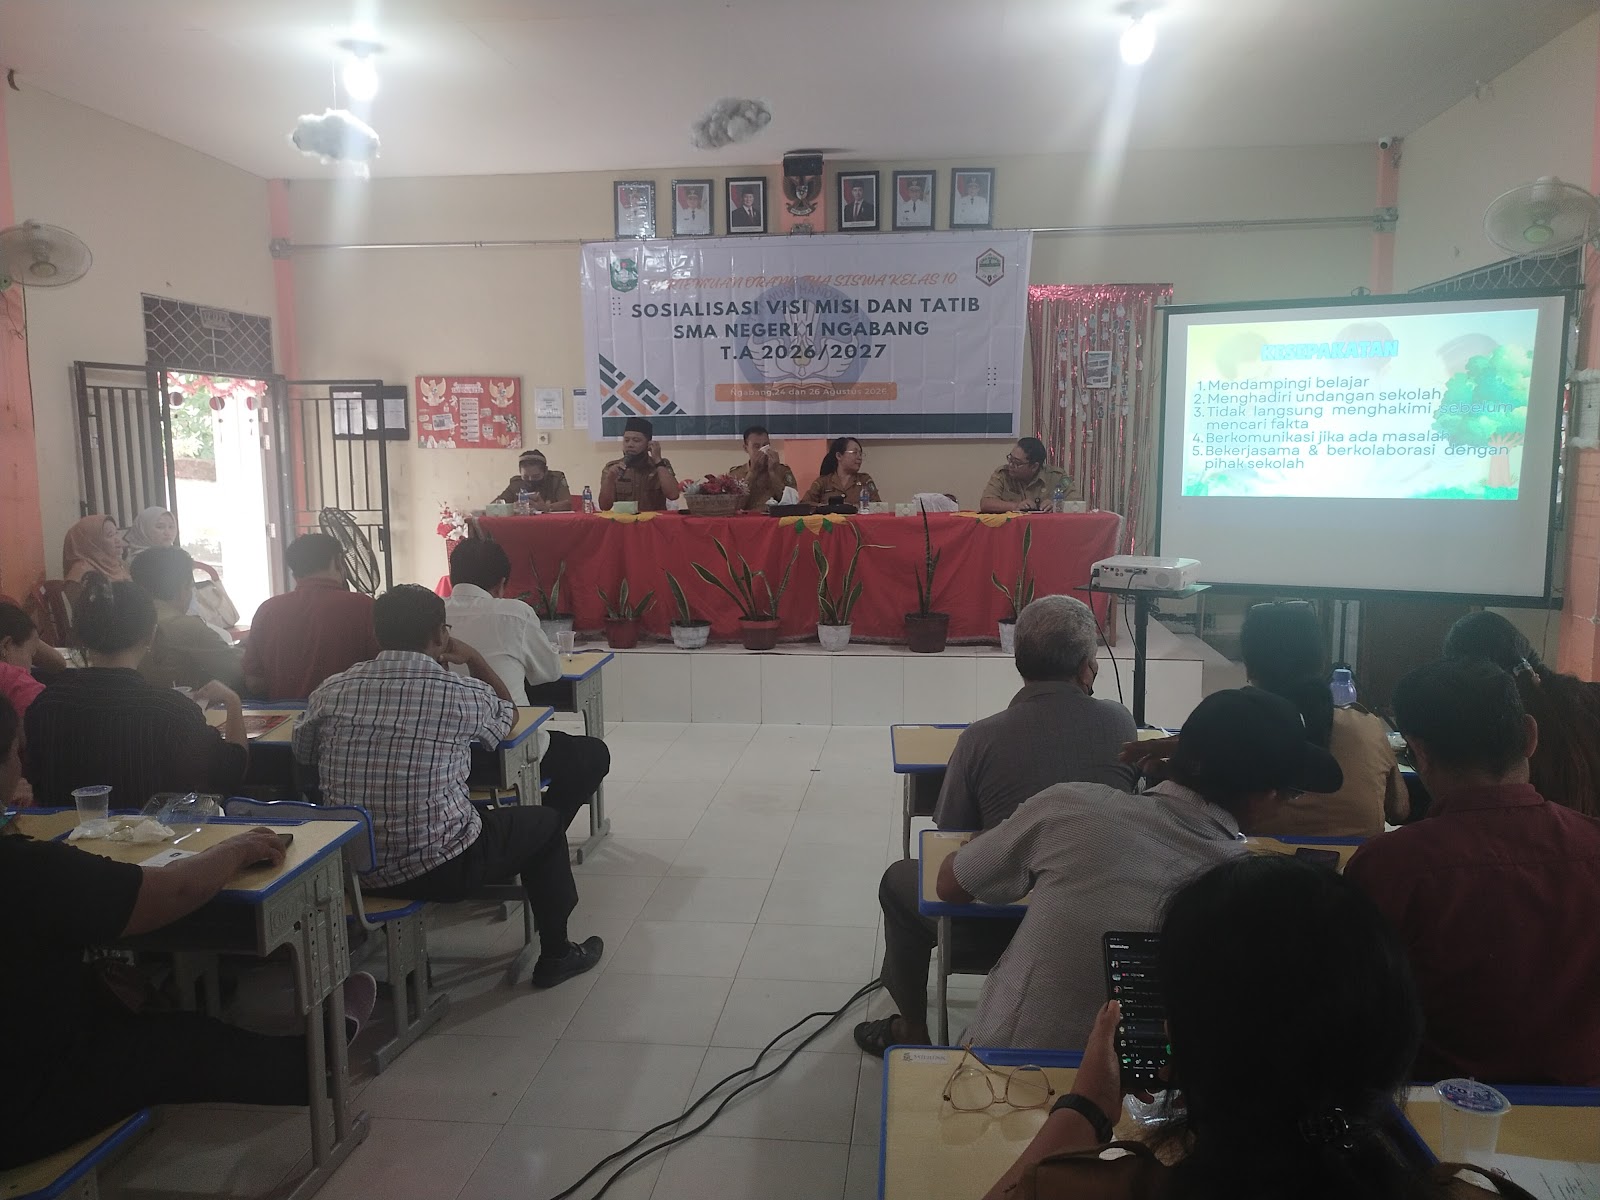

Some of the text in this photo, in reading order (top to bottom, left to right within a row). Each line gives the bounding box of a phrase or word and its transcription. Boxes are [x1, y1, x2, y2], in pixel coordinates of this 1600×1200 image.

[834, 273, 885, 287] SISWA
[891, 272, 939, 286] KELAS
[942, 272, 958, 285] 10
[631, 301, 759, 318] SOSIALISASI
[766, 299, 807, 316] VISI
[815, 299, 859, 315] MISI
[867, 298, 912, 314] DAN
[920, 297, 980, 313] TATIB
[674, 320, 929, 339] SMA NEGERI 1 NGABANG
[720, 343, 887, 361] T.A 2026/2027
[1261, 339, 1400, 362] KESEPAKATAN
[788, 388, 806, 396] dan
[809, 388, 820, 396] 26
[822, 388, 862, 398] Agustus
[1208, 377, 1311, 393] Mendampingi
[1316, 376, 1370, 391] belajar
[1208, 391, 1292, 407] Menghadiri
[1296, 390, 1375, 405] undangan
[1379, 388, 1442, 401] sekolah
[1207, 405, 1246, 417] Tidak
[1254, 405, 1323, 419] langsung
[1332, 402, 1432, 418] menghakimi
[1440, 400, 1513, 414] sebelum
[1206, 417, 1309, 430] mencari fakta
[1206, 431, 1315, 443] Berkomunikasi
[1317, 431, 1344, 445] jika
[1348, 430, 1374, 442] ada
[1382, 430, 1450, 442] masalah
[1205, 444, 1300, 459] Bekerjasama
[1308, 444, 1319, 456] &
[1327, 443, 1436, 456] berkolaborasi
[1444, 443, 1510, 459] dengan
[1204, 457, 1305, 471] pihak sekolah
